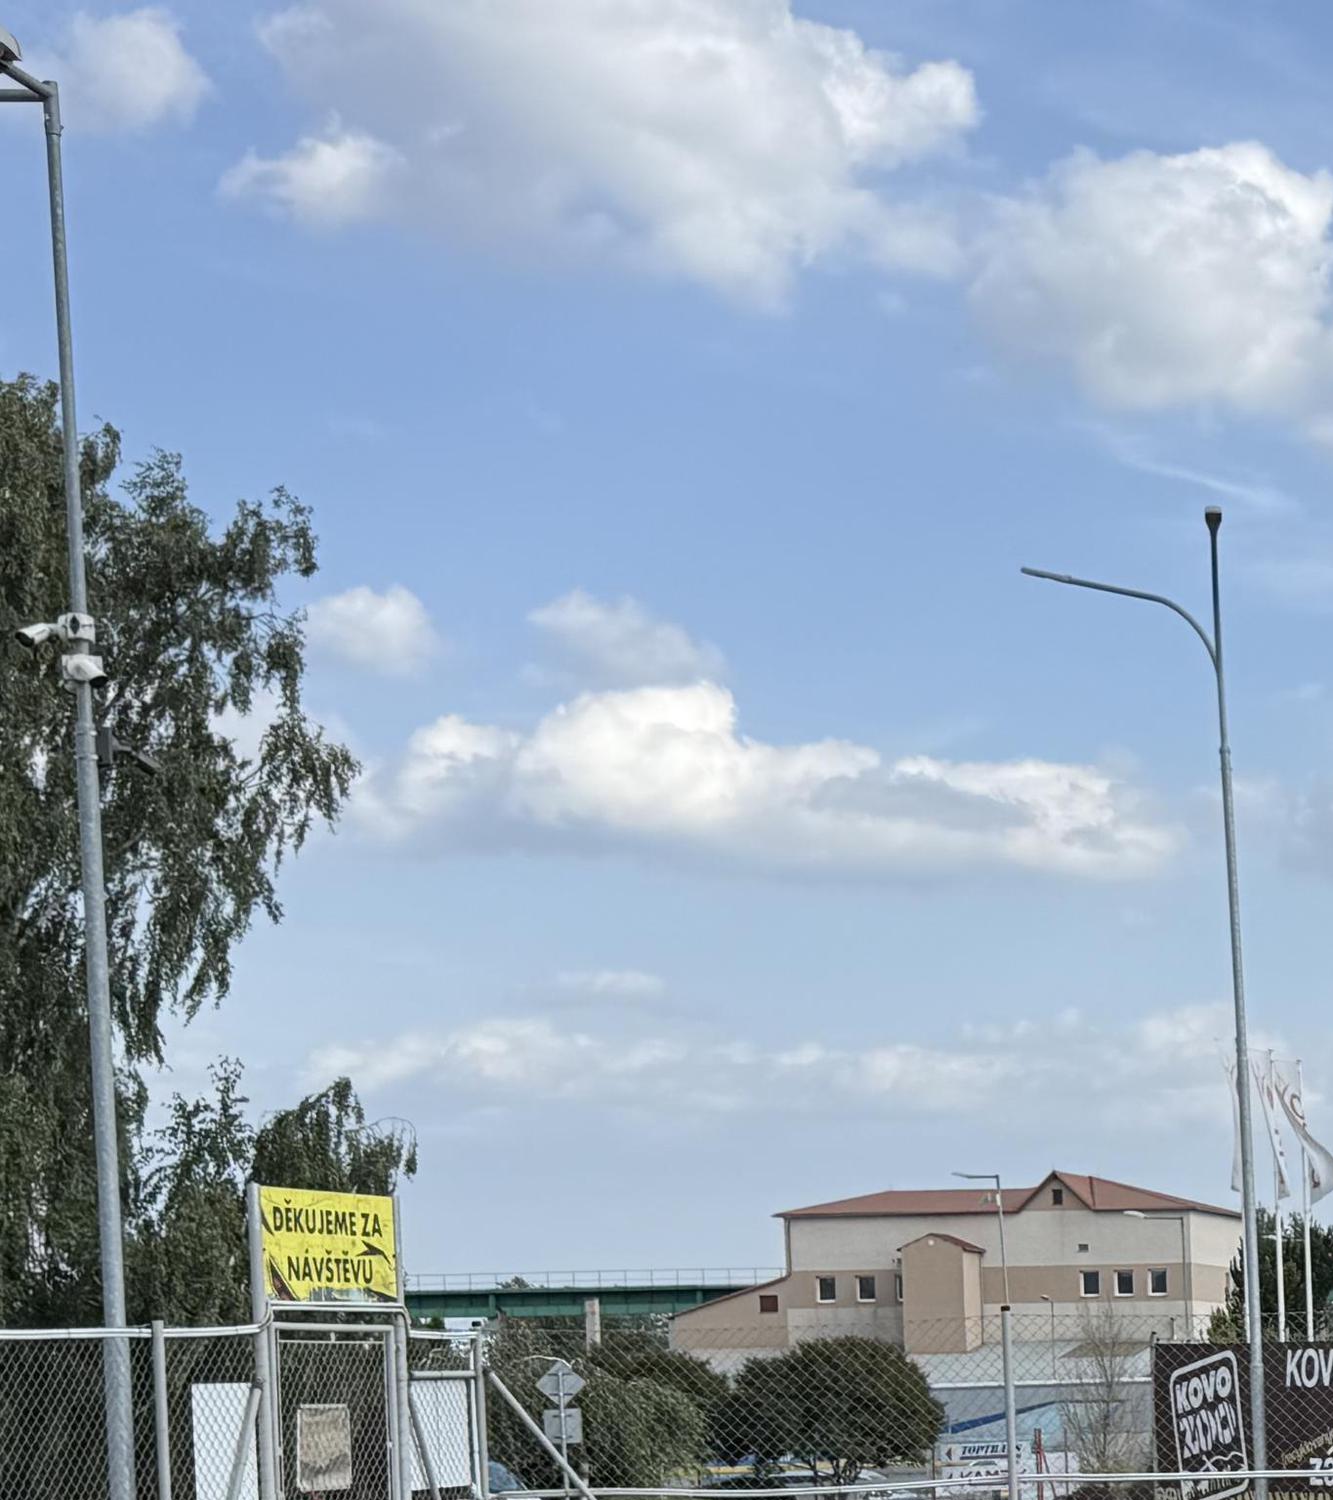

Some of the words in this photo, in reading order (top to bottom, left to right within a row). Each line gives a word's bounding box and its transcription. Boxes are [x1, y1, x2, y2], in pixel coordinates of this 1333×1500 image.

[272, 1198, 357, 1236] DĚKUJEME
[360, 1212, 383, 1238] ZA
[287, 1248, 373, 1285] NÁVŠTĚVU
[1175, 1366, 1232, 1414] KOVO
